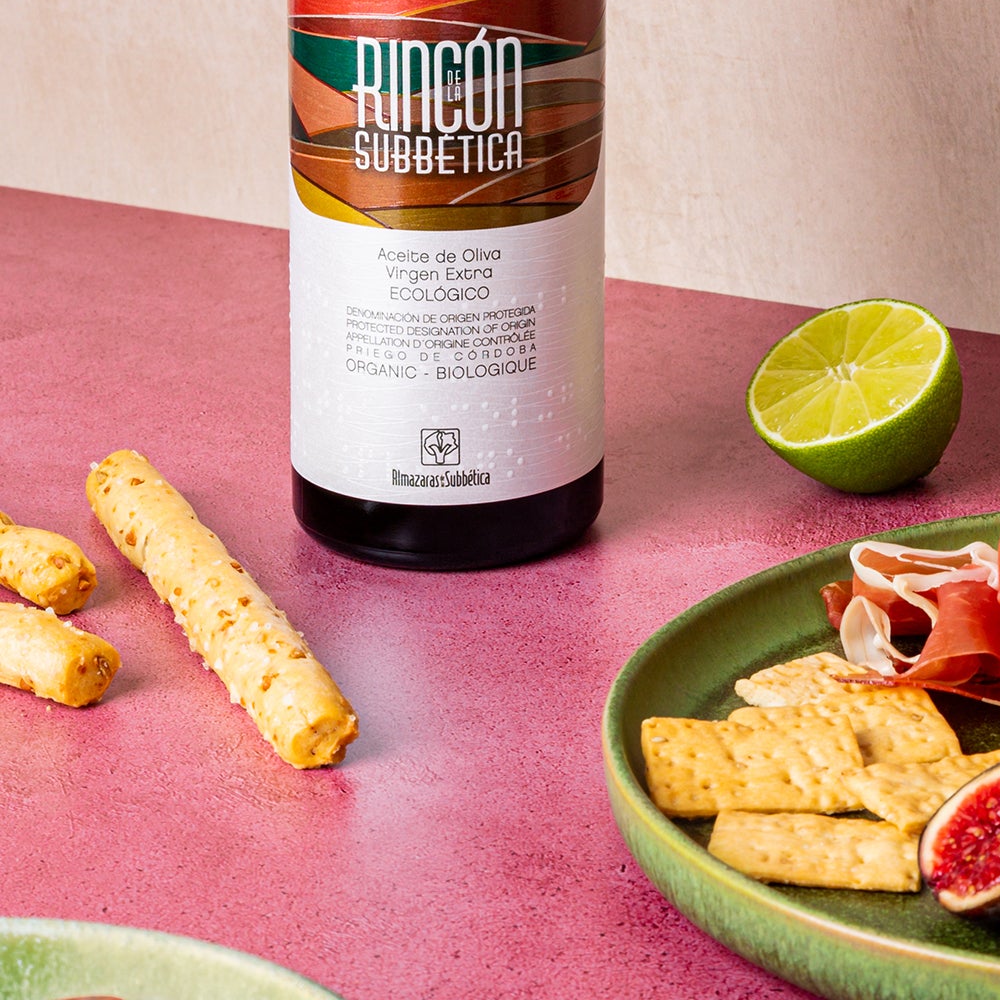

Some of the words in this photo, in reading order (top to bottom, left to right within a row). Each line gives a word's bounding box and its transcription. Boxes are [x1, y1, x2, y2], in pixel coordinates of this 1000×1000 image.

[352, 26, 524, 134] RINCÓN
[448, 70, 461, 86] DE
[448, 86, 461, 102] LA
[355, 131, 523, 175] SUBBÉTICA
[377, 248, 430, 263] Aceite
[435, 249, 457, 263] de
[462, 248, 501, 263] Oliva
[386, 265, 439, 284] Virgen
[446, 267, 493, 280] Extra
[390, 285, 490, 302] ECOLÓGICO
[346, 306, 420, 323] DENOMINACIÓN
[423, 313, 438, 324] DE
[439, 312, 480, 323] ORIGEN
[483, 305, 536, 321] PROTEGIDA
[346, 319, 404, 335] PROTECTED
[407, 325, 480, 336] DESIGNATION
[483, 323, 499, 333] OF
[500, 318, 536, 332] ORIGIN
[346, 332, 410, 348] APPELLATION
[473, 330, 536, 347] CONTRÔLÉE
[346, 344, 407, 361] PRIEGO
[420, 352, 440, 362] DE
[454, 343, 537, 361] CÓRDOBA
[346, 358, 417, 379] ORGANIC
[436, 357, 537, 380] BIOLOGIQUE
[392, 469, 440, 488] Almazaras
[444, 469, 491, 488] Subbética
